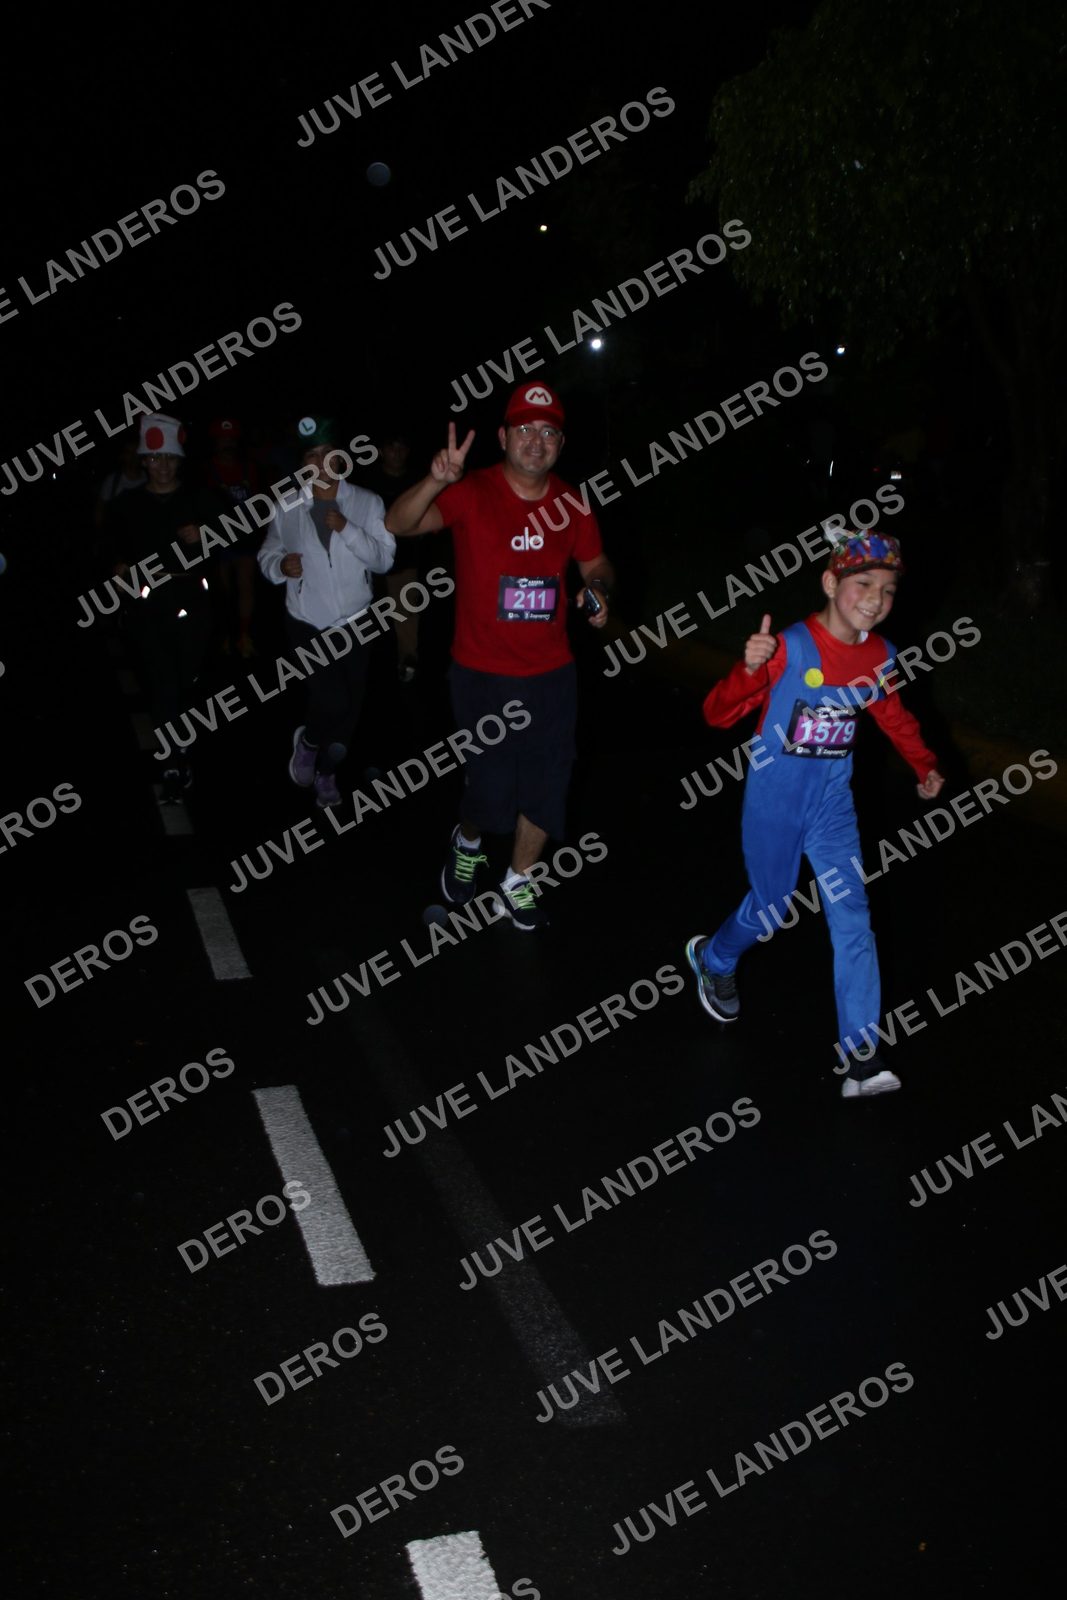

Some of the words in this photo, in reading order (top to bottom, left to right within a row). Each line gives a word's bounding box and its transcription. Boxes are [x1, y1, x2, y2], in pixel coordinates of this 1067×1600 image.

[511, 527, 544, 551] alo
[513, 590, 546, 609] 211
[801, 719, 856, 743] 1579
